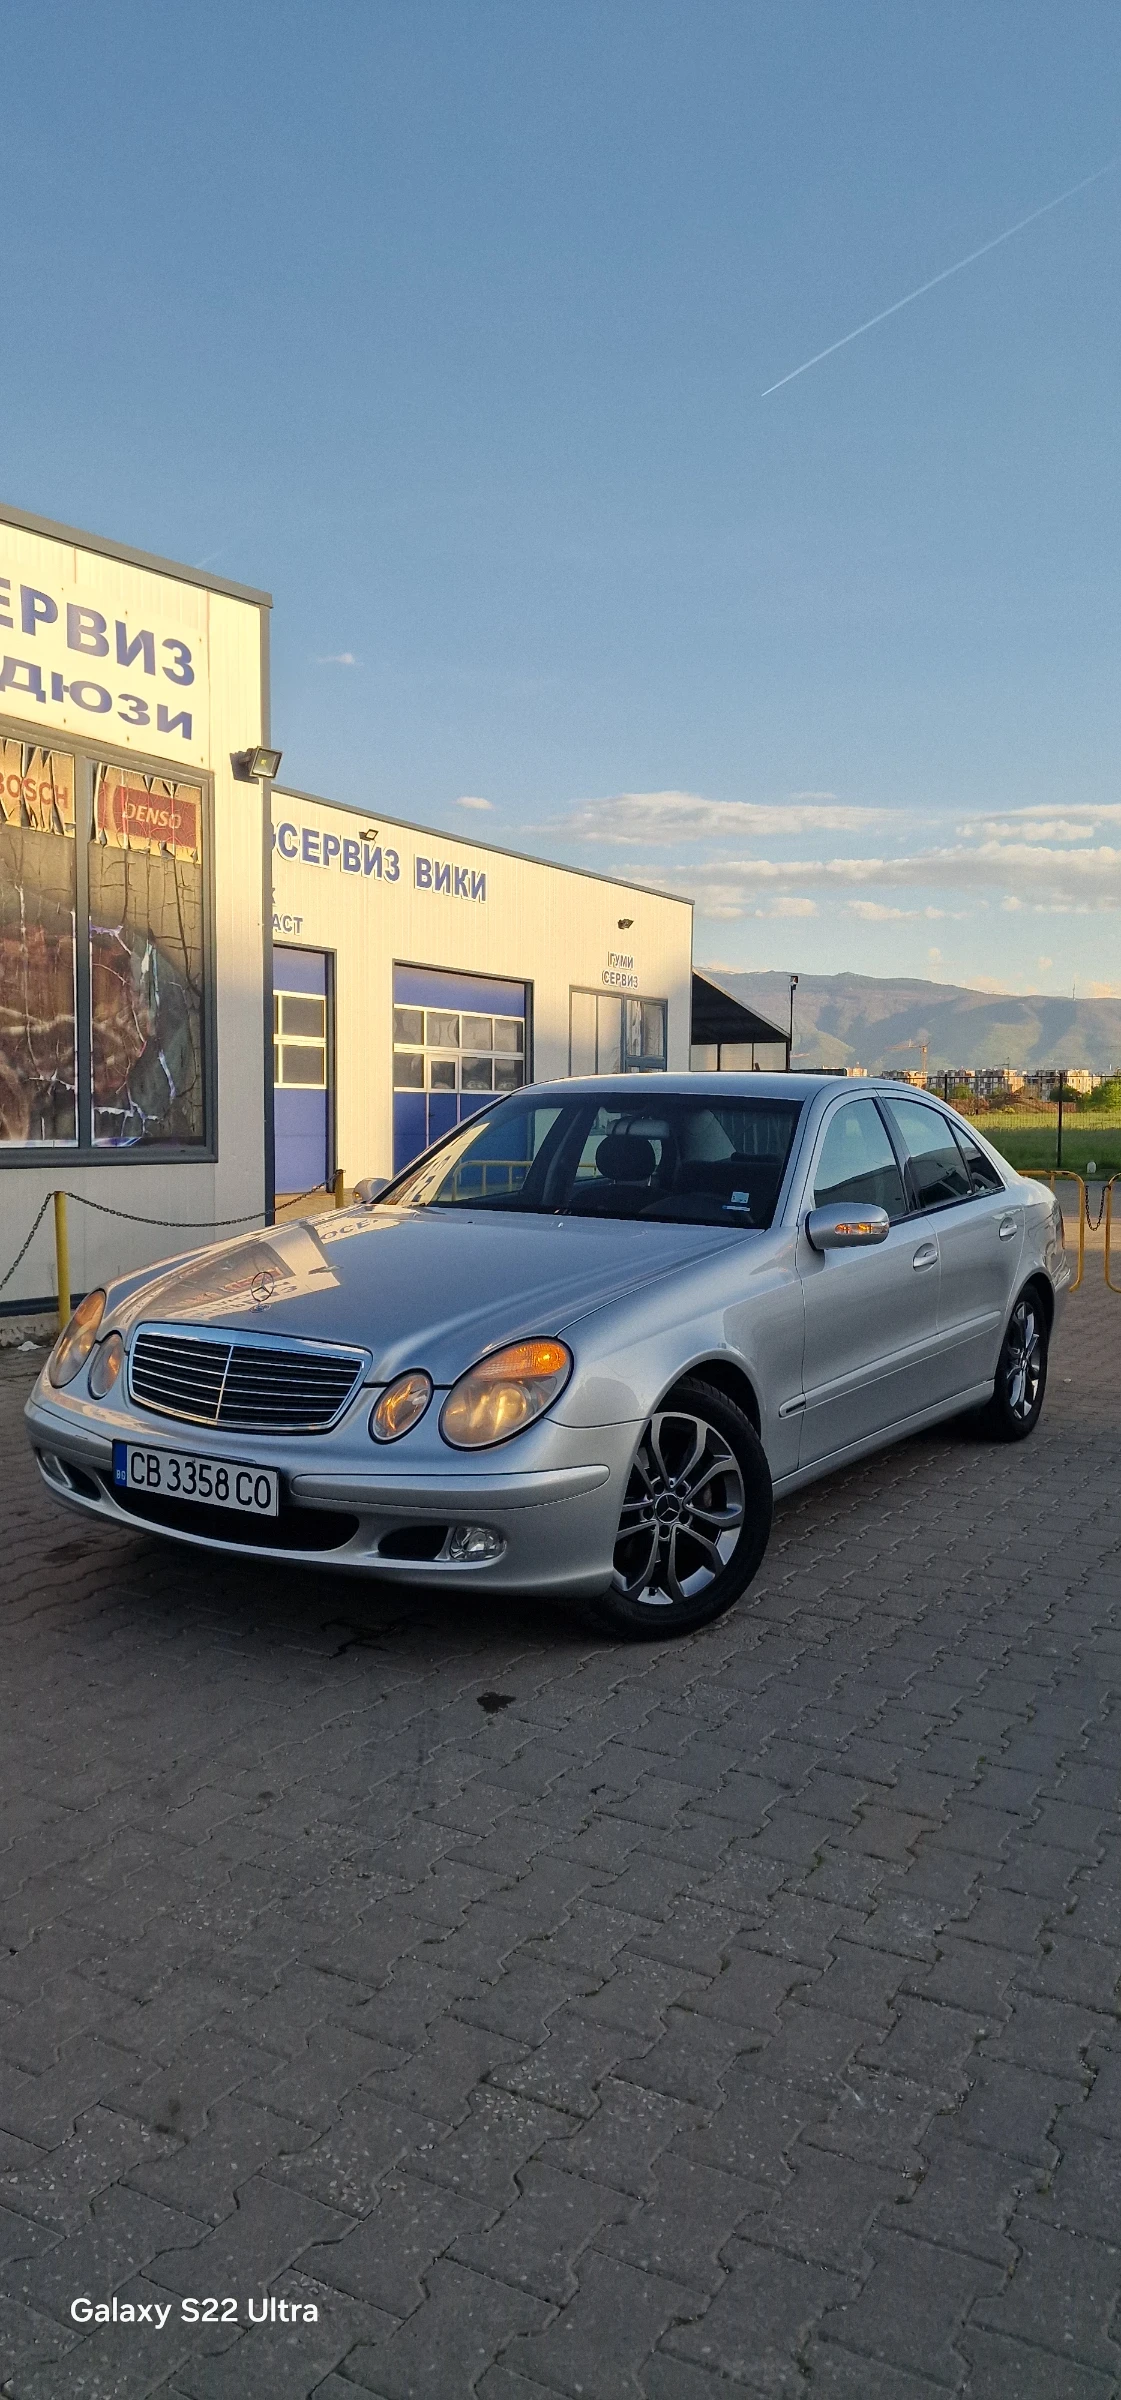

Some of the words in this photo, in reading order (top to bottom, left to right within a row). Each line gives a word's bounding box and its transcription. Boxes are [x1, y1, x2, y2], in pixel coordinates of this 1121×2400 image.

[0, 655, 193, 741] ДЮЗИ
[124, 803, 181, 829] DENSO
[272, 822, 400, 882] СЕРВИЗ
[416, 856, 486, 902] ВИКИ
[609, 952, 634, 969] ГУМИ
[603, 970, 638, 988] СЕРВИЗ
[116, 1469, 126, 1481] BG
[130, 1451, 161, 1488] CB
[166, 1458, 229, 1501] 3358
[236, 1471, 271, 1509] CO
